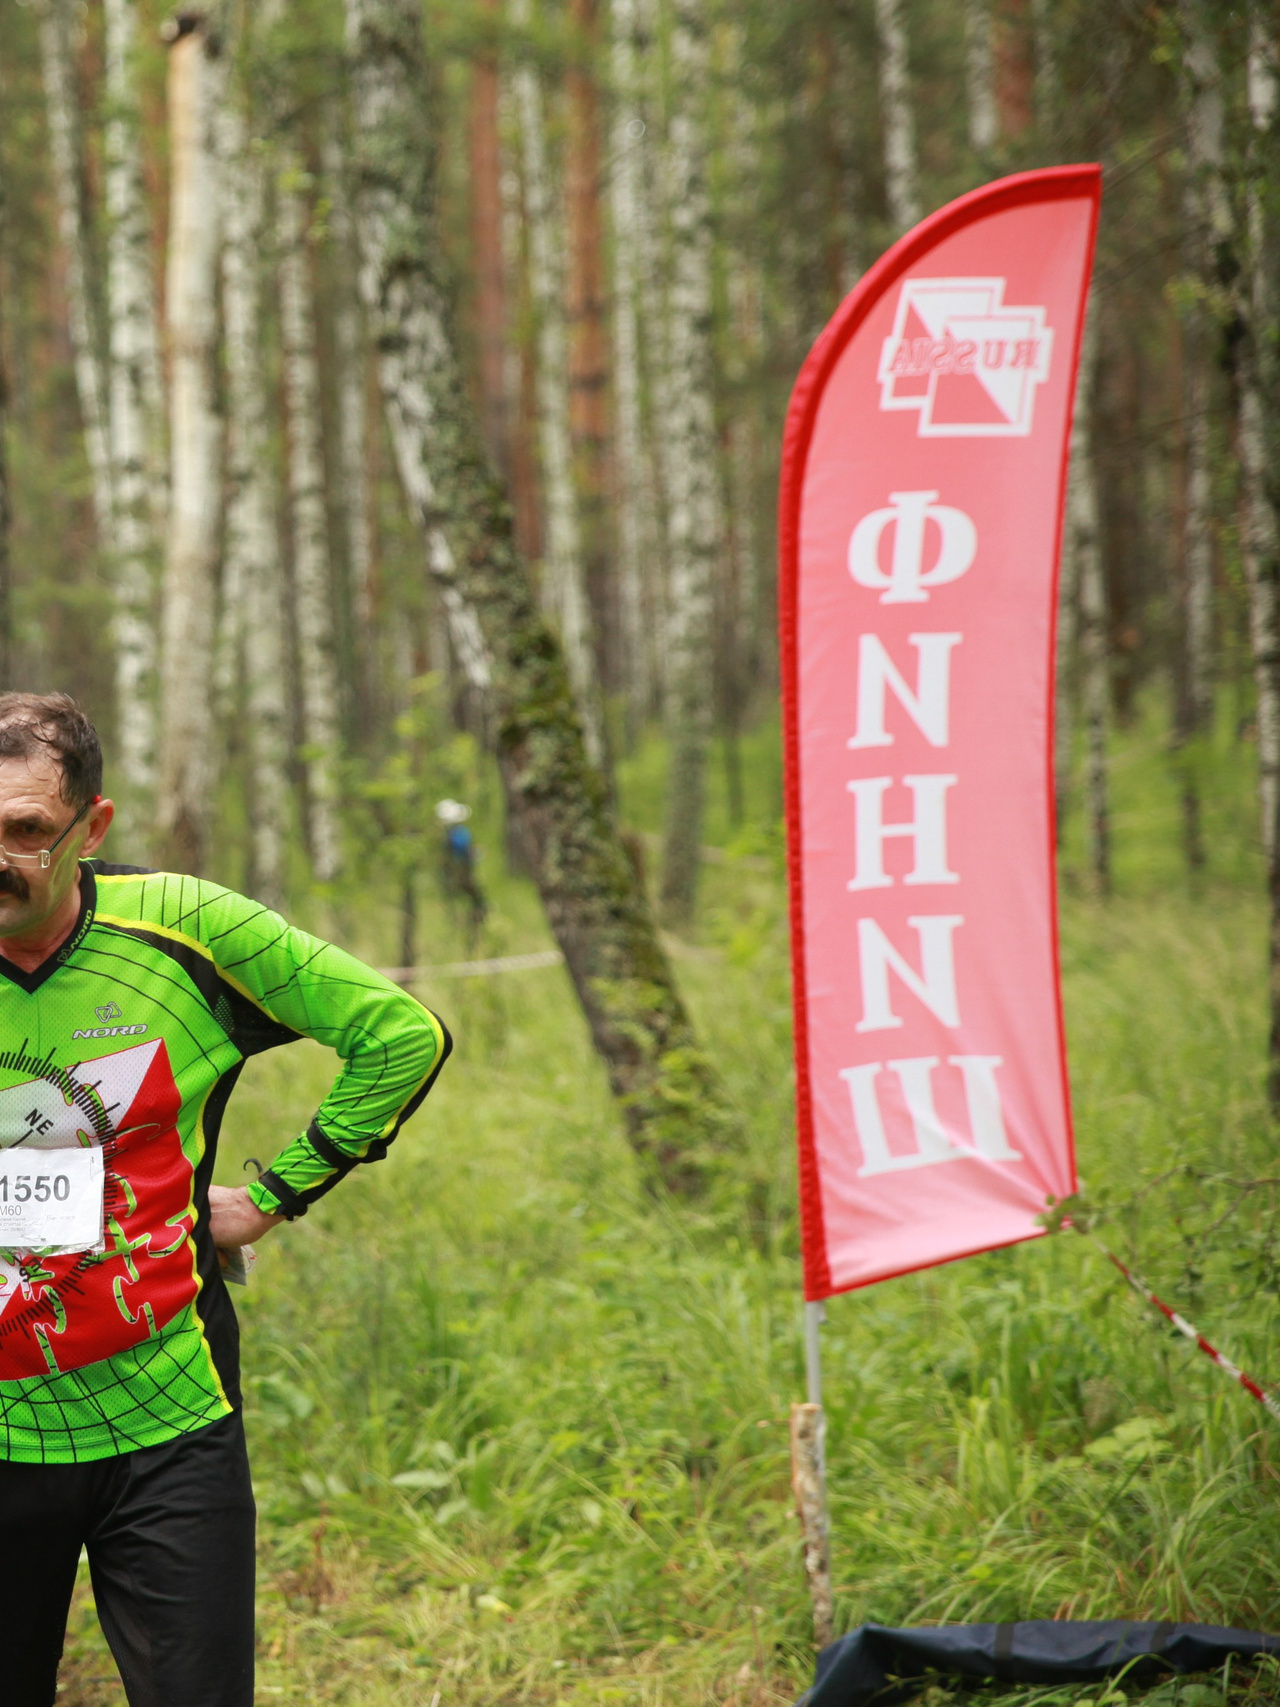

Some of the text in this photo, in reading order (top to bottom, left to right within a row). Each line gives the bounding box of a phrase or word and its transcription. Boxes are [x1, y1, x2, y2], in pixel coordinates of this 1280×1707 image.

[70, 909, 93, 949] NORD
[72, 1024, 147, 1039] NORD
[24, 1108, 54, 1136] NE
